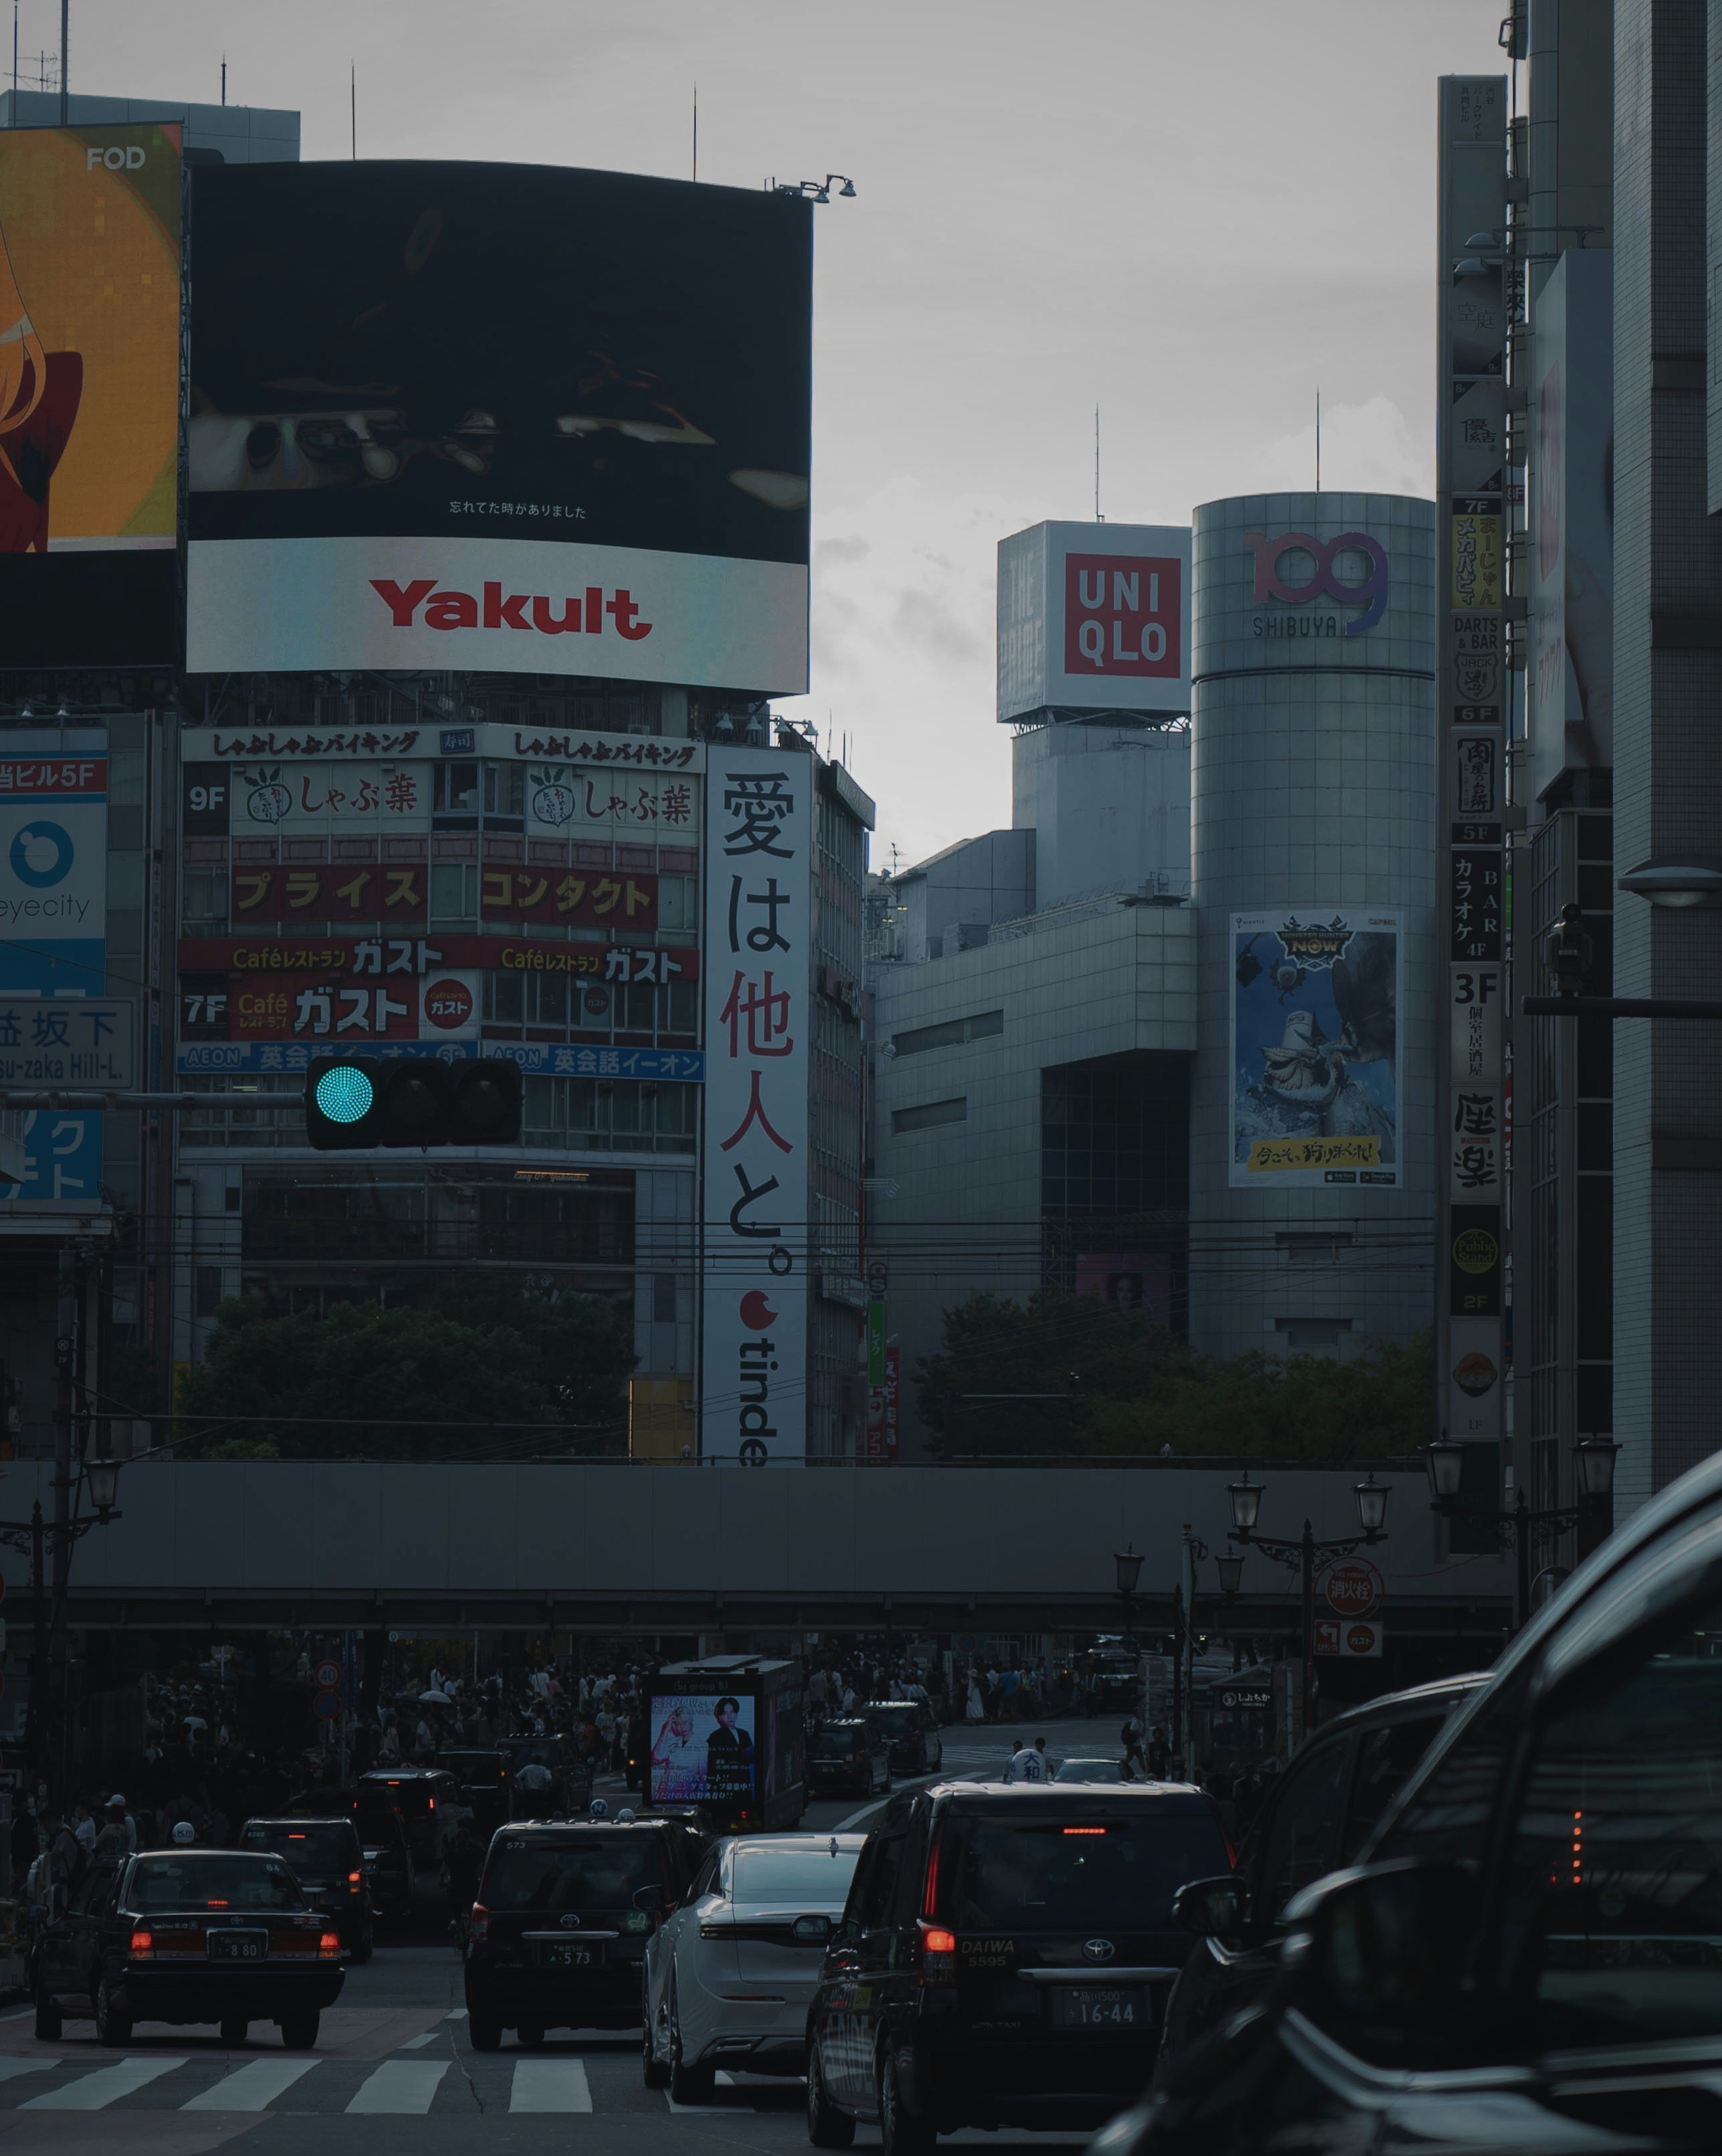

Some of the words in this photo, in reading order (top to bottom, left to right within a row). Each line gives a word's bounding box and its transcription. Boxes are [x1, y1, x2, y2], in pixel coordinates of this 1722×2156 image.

[87, 147, 145, 170] FOD
[449, 500, 586, 519] 忘れてた時がありました
[1465, 500, 1489, 513] 7F
[1480, 517, 1497, 605] まーじゃん
[1078, 569, 1159, 612] UNI
[1243, 531, 1388, 636] 109
[369, 579, 652, 640] Yakult
[1252, 615, 1337, 638] SHIBUYA
[1454, 617, 1498, 633] DARTS
[1078, 619, 1167, 667] QLO
[1458, 638, 1466, 649] &
[1471, 634, 1498, 649] BAR
[1461, 657, 1492, 667] JACK
[213, 730, 419, 756] しゃぶしゃぶバイキング
[514, 731, 696, 767] しゃぶしゃぶバイキング
[190, 786, 225, 811] 9F
[301, 773, 417, 813] しゃぶ葉
[585, 780, 691, 825] しゃぶ葉
[1463, 826, 1489, 840] 5F
[235, 870, 421, 909] プライス
[482, 872, 652, 916] コンタクト
[1456, 859, 1474, 942] カラオケ
[1482, 871, 1499, 932] BAR
[352, 937, 442, 974] ガスト
[1292, 939, 1339, 954] NOW
[1467, 943, 1487, 956] 4F
[604, 947, 682, 983] ガスト
[1454, 973, 1497, 1005] 3F
[184, 995, 227, 1023] 7F
[238, 993, 288, 1014] Café
[294, 986, 408, 1034] ガスト
[431, 1000, 468, 1015] ガスト
[239, 1016, 287, 1029] レストラン
[1469, 1006, 1483, 1077] 個室居酒屋
[187, 1049, 241, 1065] AEON
[554, 1048, 700, 1076] 英会話イーオン
[1458, 1252, 1492, 1262] Stand
[1459, 1240, 1495, 1251] Public
[1463, 1295, 1488, 1308] 2F
[1469, 1419, 1484, 1430] 1F
[1331, 1580, 1370, 1600] 消火栓
[320, 1669, 336, 1681] 40
[689, 1683, 716, 1691] group
[1238, 1693, 1271, 1702] しぶちか
[1023, 1752, 1039, 1780] 大和
[961, 1939, 1015, 1954] DAIWA
[968, 1956, 1006, 1967] 5595
[1082, 2003, 1135, 2023] 16-44
